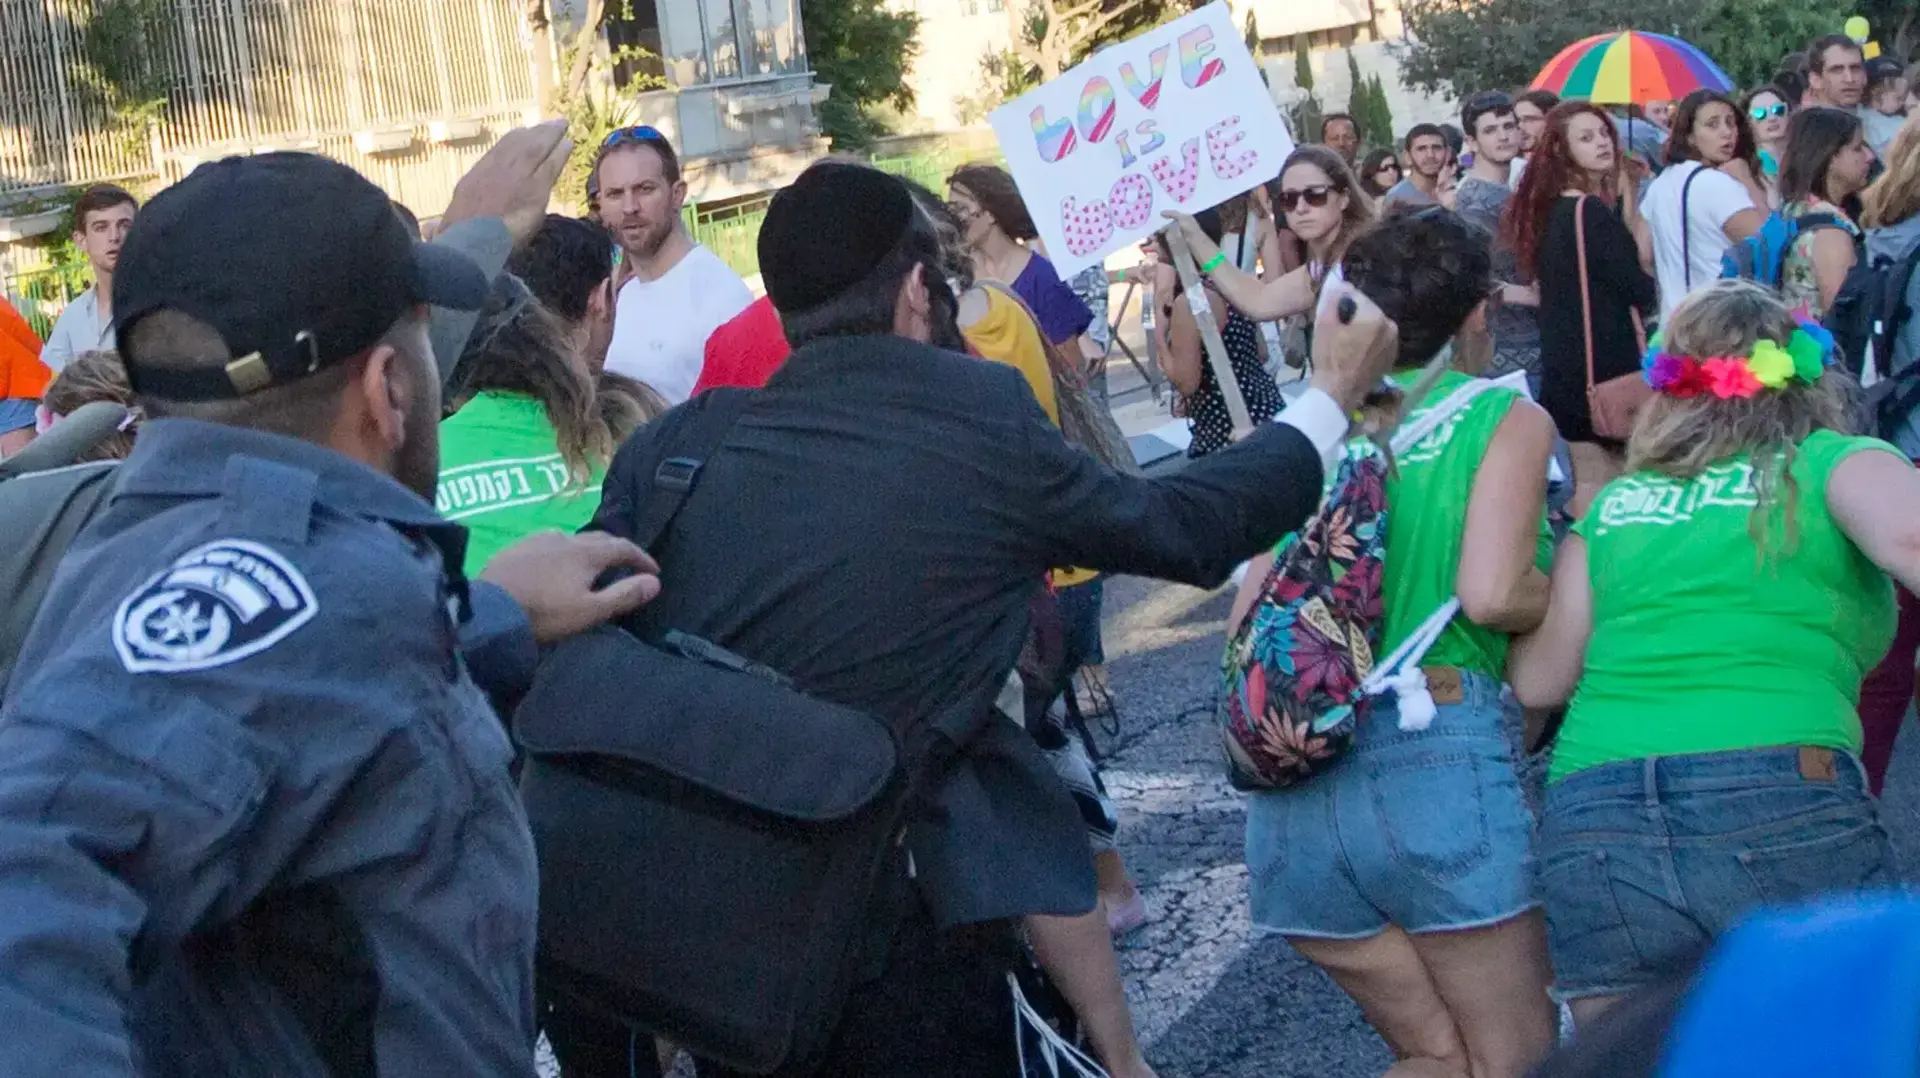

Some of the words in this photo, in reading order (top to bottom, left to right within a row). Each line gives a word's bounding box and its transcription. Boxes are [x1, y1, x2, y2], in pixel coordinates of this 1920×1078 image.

[1028, 24, 1226, 163] LOVE
[1114, 118, 1166, 169] IS
[1060, 114, 1259, 258] LOVE
